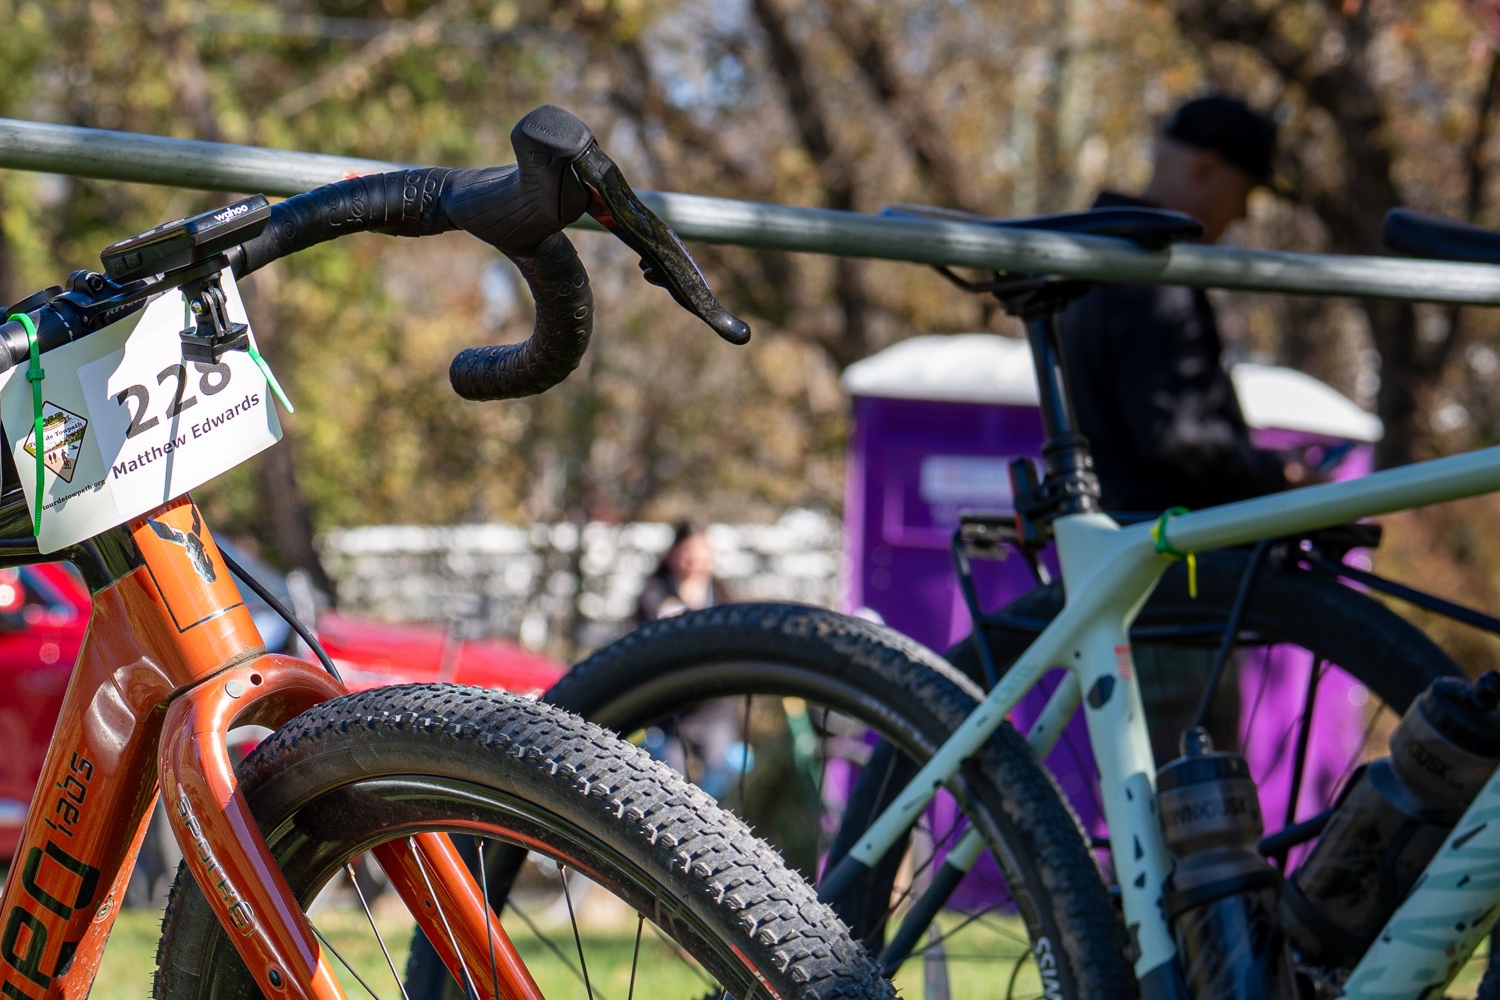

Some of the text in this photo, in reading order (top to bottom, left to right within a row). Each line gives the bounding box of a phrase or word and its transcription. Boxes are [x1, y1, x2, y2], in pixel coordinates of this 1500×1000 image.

[214, 204, 248, 222] wahoo
[112, 393, 260, 479] Matthew Edwards
[117, 362, 232, 440] 228
[42, 479, 106, 511] tourdetowpath.org
[44, 752, 94, 838] labs
